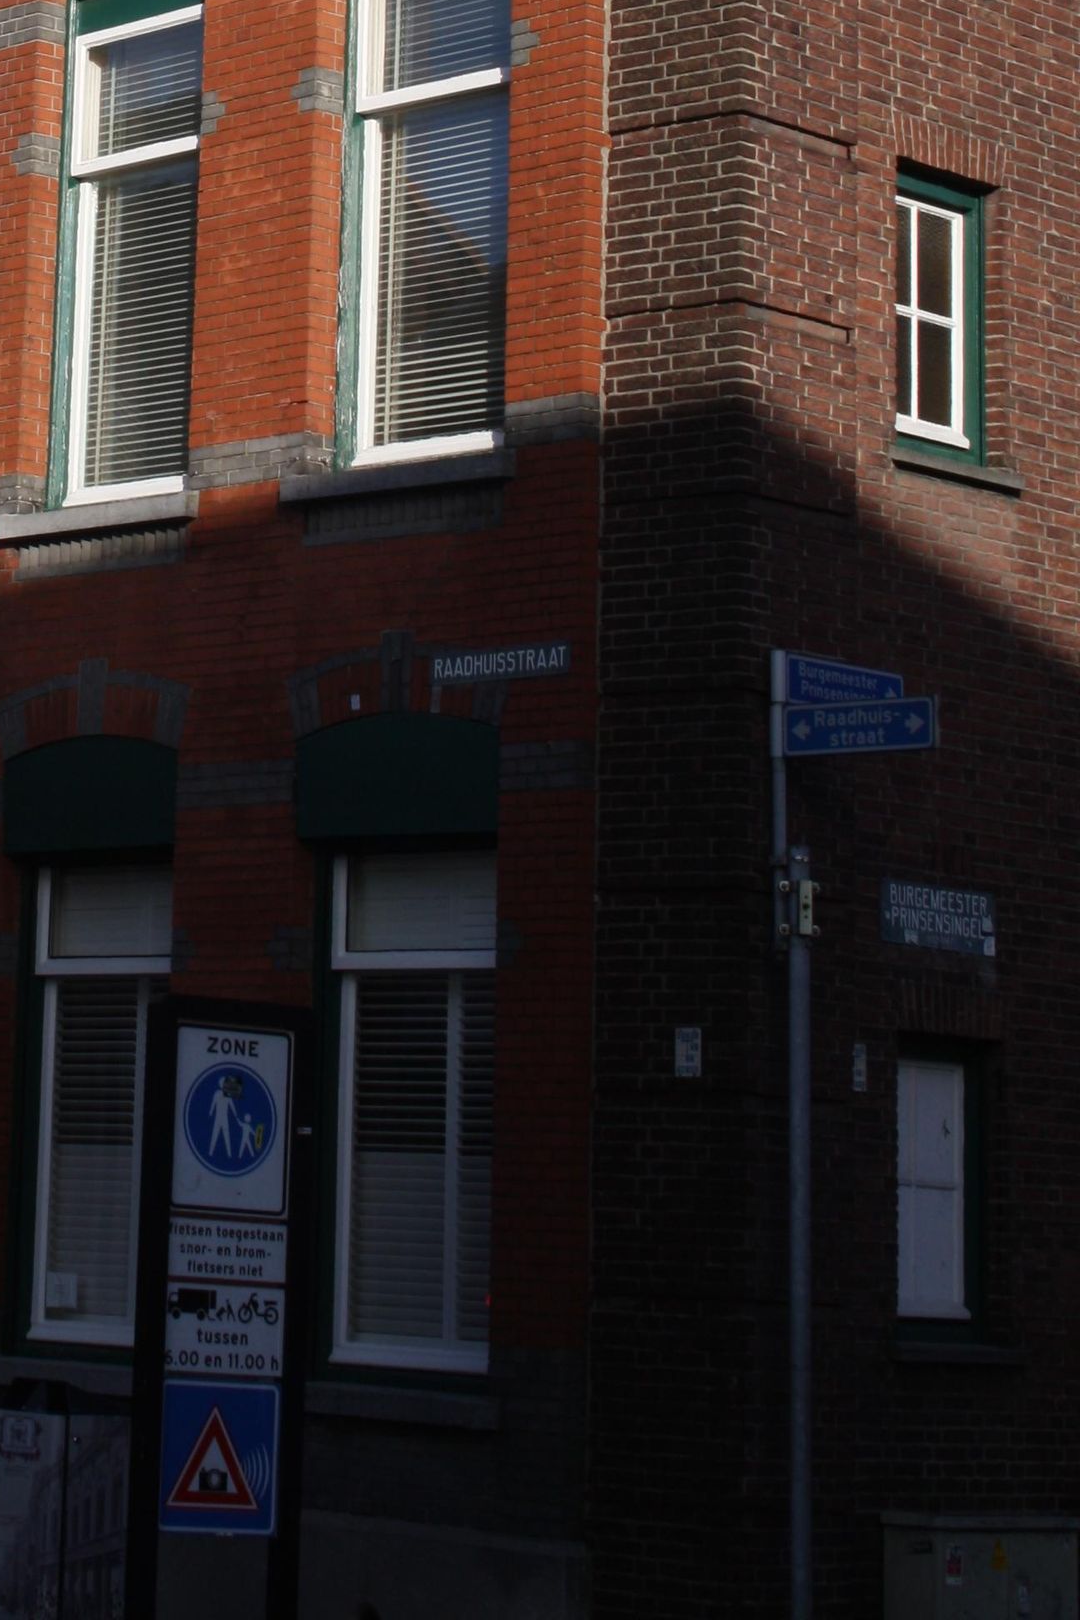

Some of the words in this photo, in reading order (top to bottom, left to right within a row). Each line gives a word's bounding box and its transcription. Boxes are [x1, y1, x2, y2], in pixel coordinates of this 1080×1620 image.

[434, 646, 566, 679] RAADHUISSTRAAT
[797, 661, 878, 690] Burgemeester
[813, 708, 902, 728] Raadhuis-
[829, 727, 886, 747] straat
[889, 883, 987, 916] BURGEMEESTER
[891, 906, 984, 940] PRINSENSINGEL
[207, 1036, 259, 1058] ZONE
[216, 1226, 284, 1242] toegestaan
[180, 1243, 212, 1255] snor-
[217, 1246, 231, 1257] en
[236, 1245, 271, 1259] brom-
[188, 1260, 234, 1275] fietsers
[239, 1265, 263, 1277] niet
[197, 1329, 248, 1345] tussen
[204, 1355, 222, 1368] en
[228, 1353, 265, 1370] 11.00
[271, 1356, 279, 1371] h
